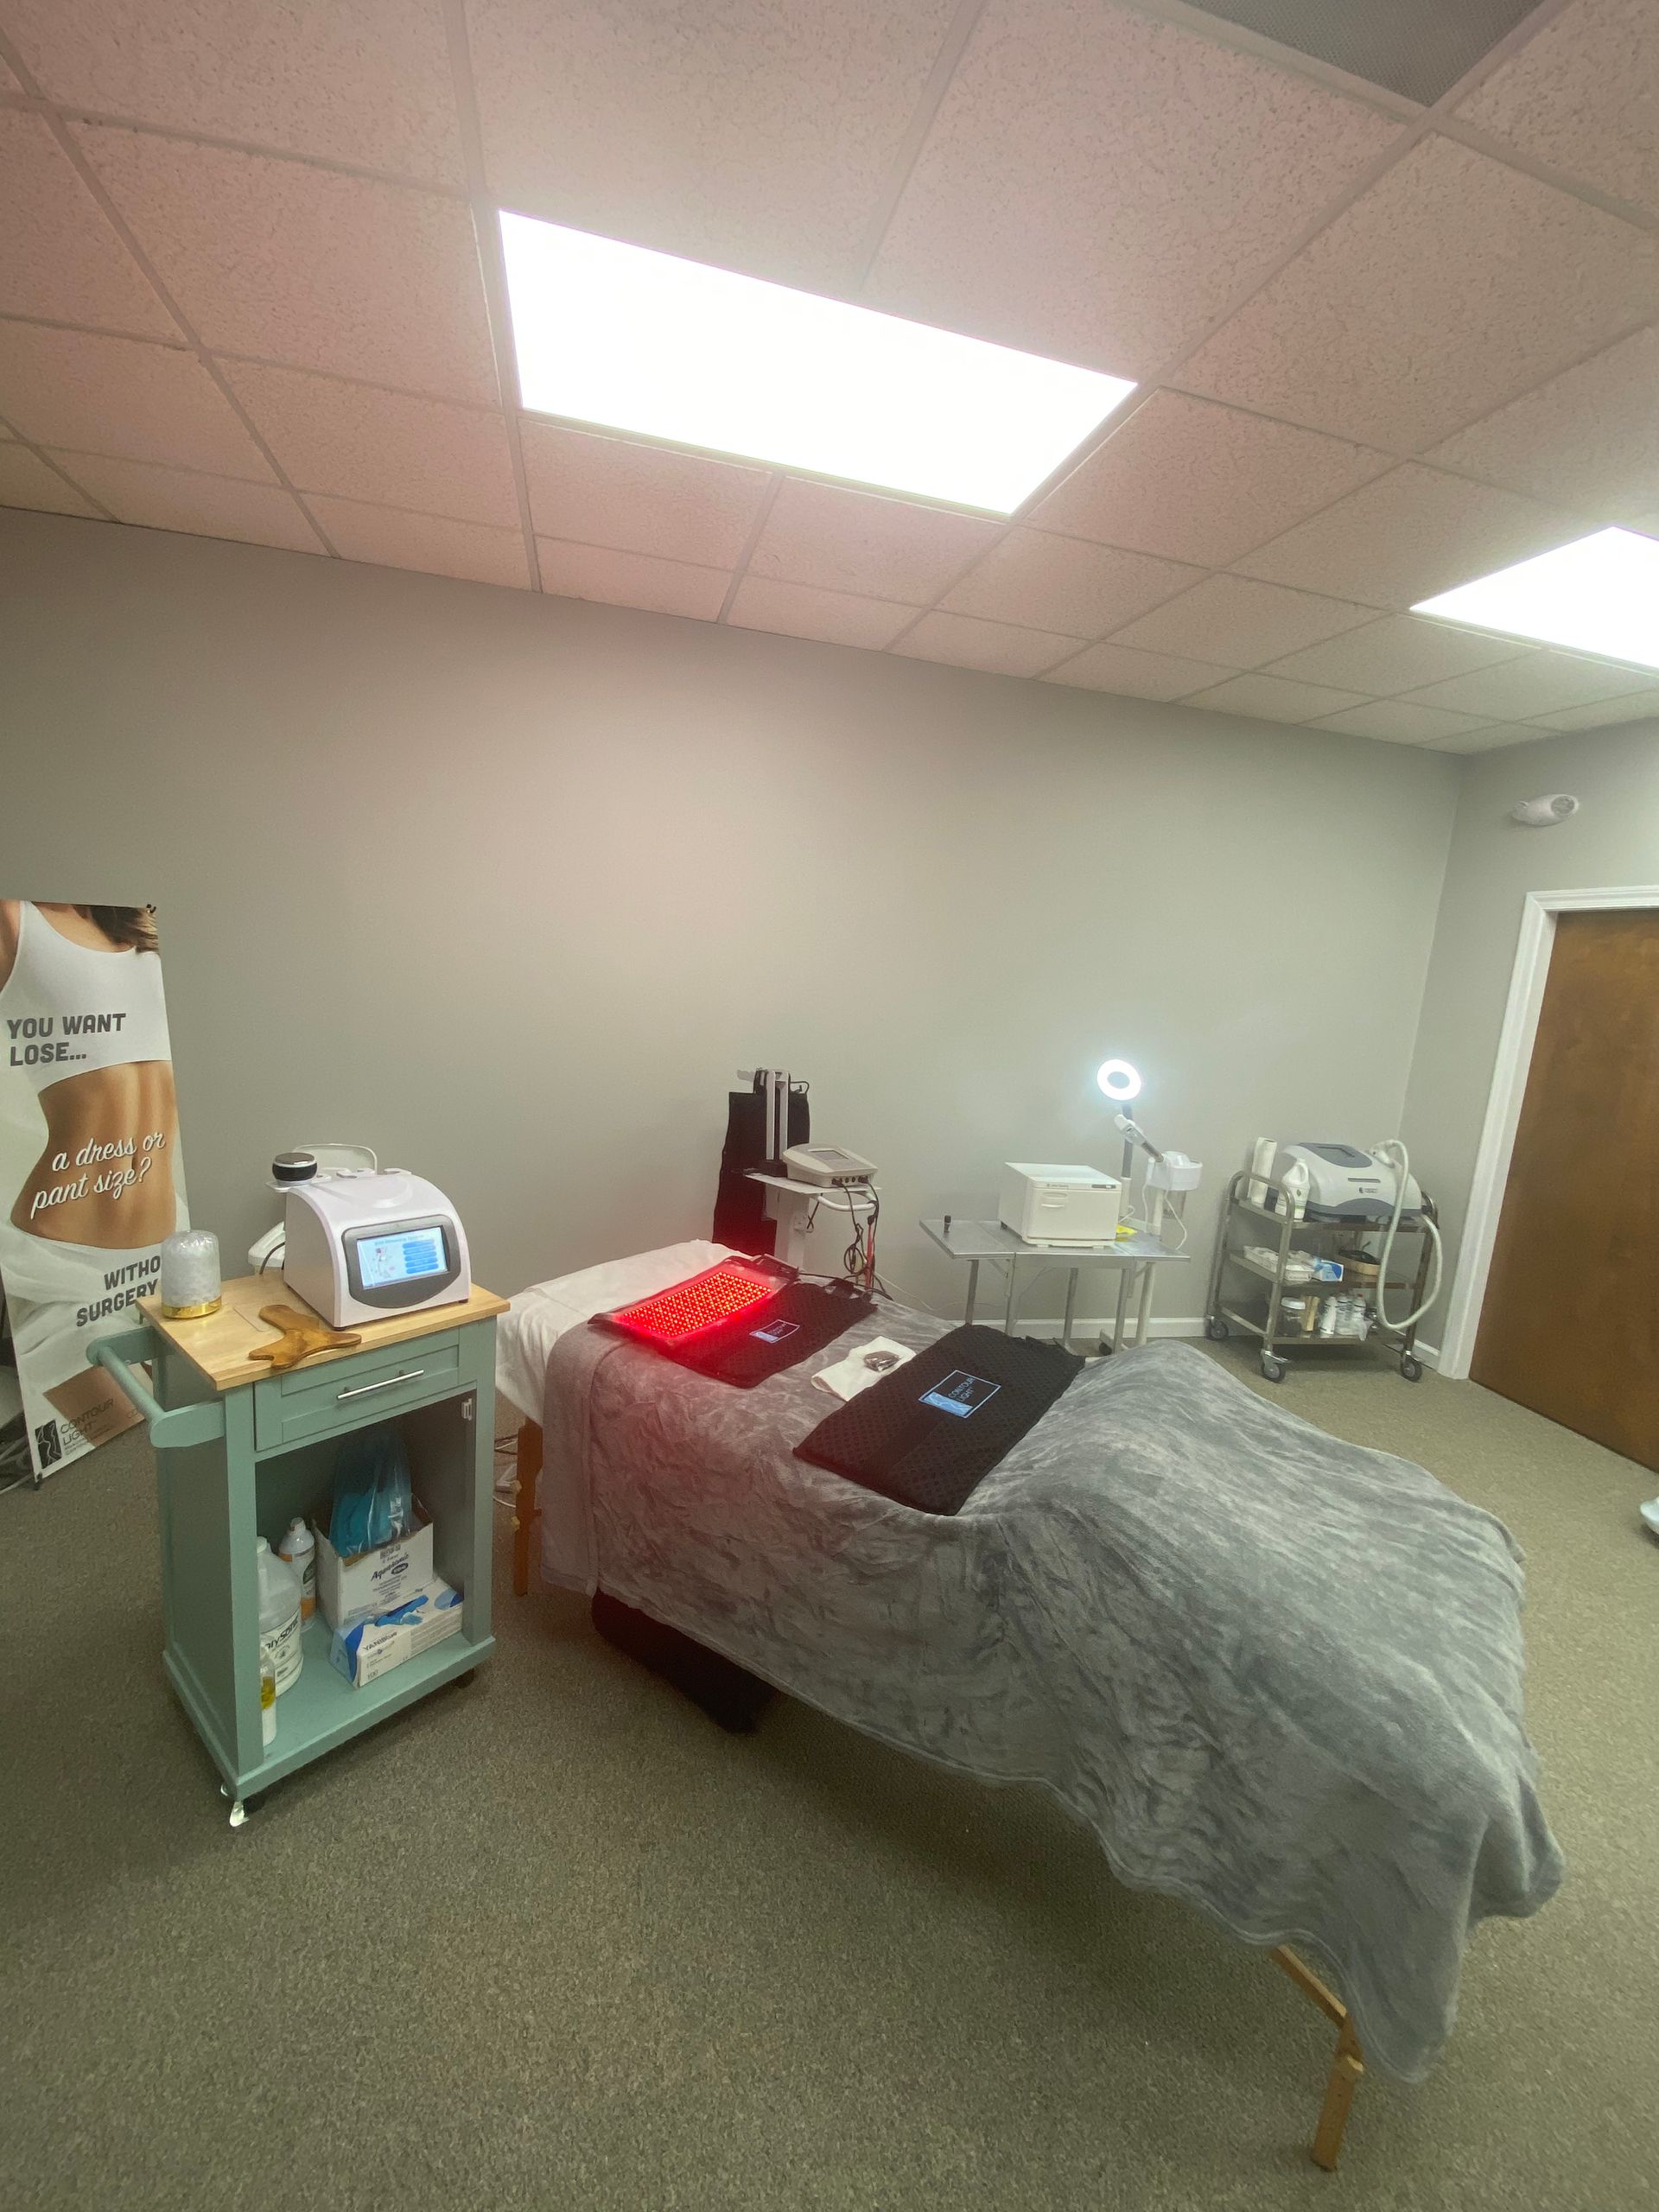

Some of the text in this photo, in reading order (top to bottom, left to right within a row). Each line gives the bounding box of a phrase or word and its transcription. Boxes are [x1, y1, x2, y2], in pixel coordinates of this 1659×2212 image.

[7, 1013, 126, 1039] YOU WANT
[10, 1041, 87, 1066] LOSE...
[52, 1132, 165, 1172] a dress or
[30, 1157, 151, 1220] pant size?
[76, 1278, 159, 1327] SURGERY
[949, 1377, 976, 1397] CONTOUR
[60, 1398, 114, 1434] CONTOUR
[62, 1421, 92, 1446] LIGHT
